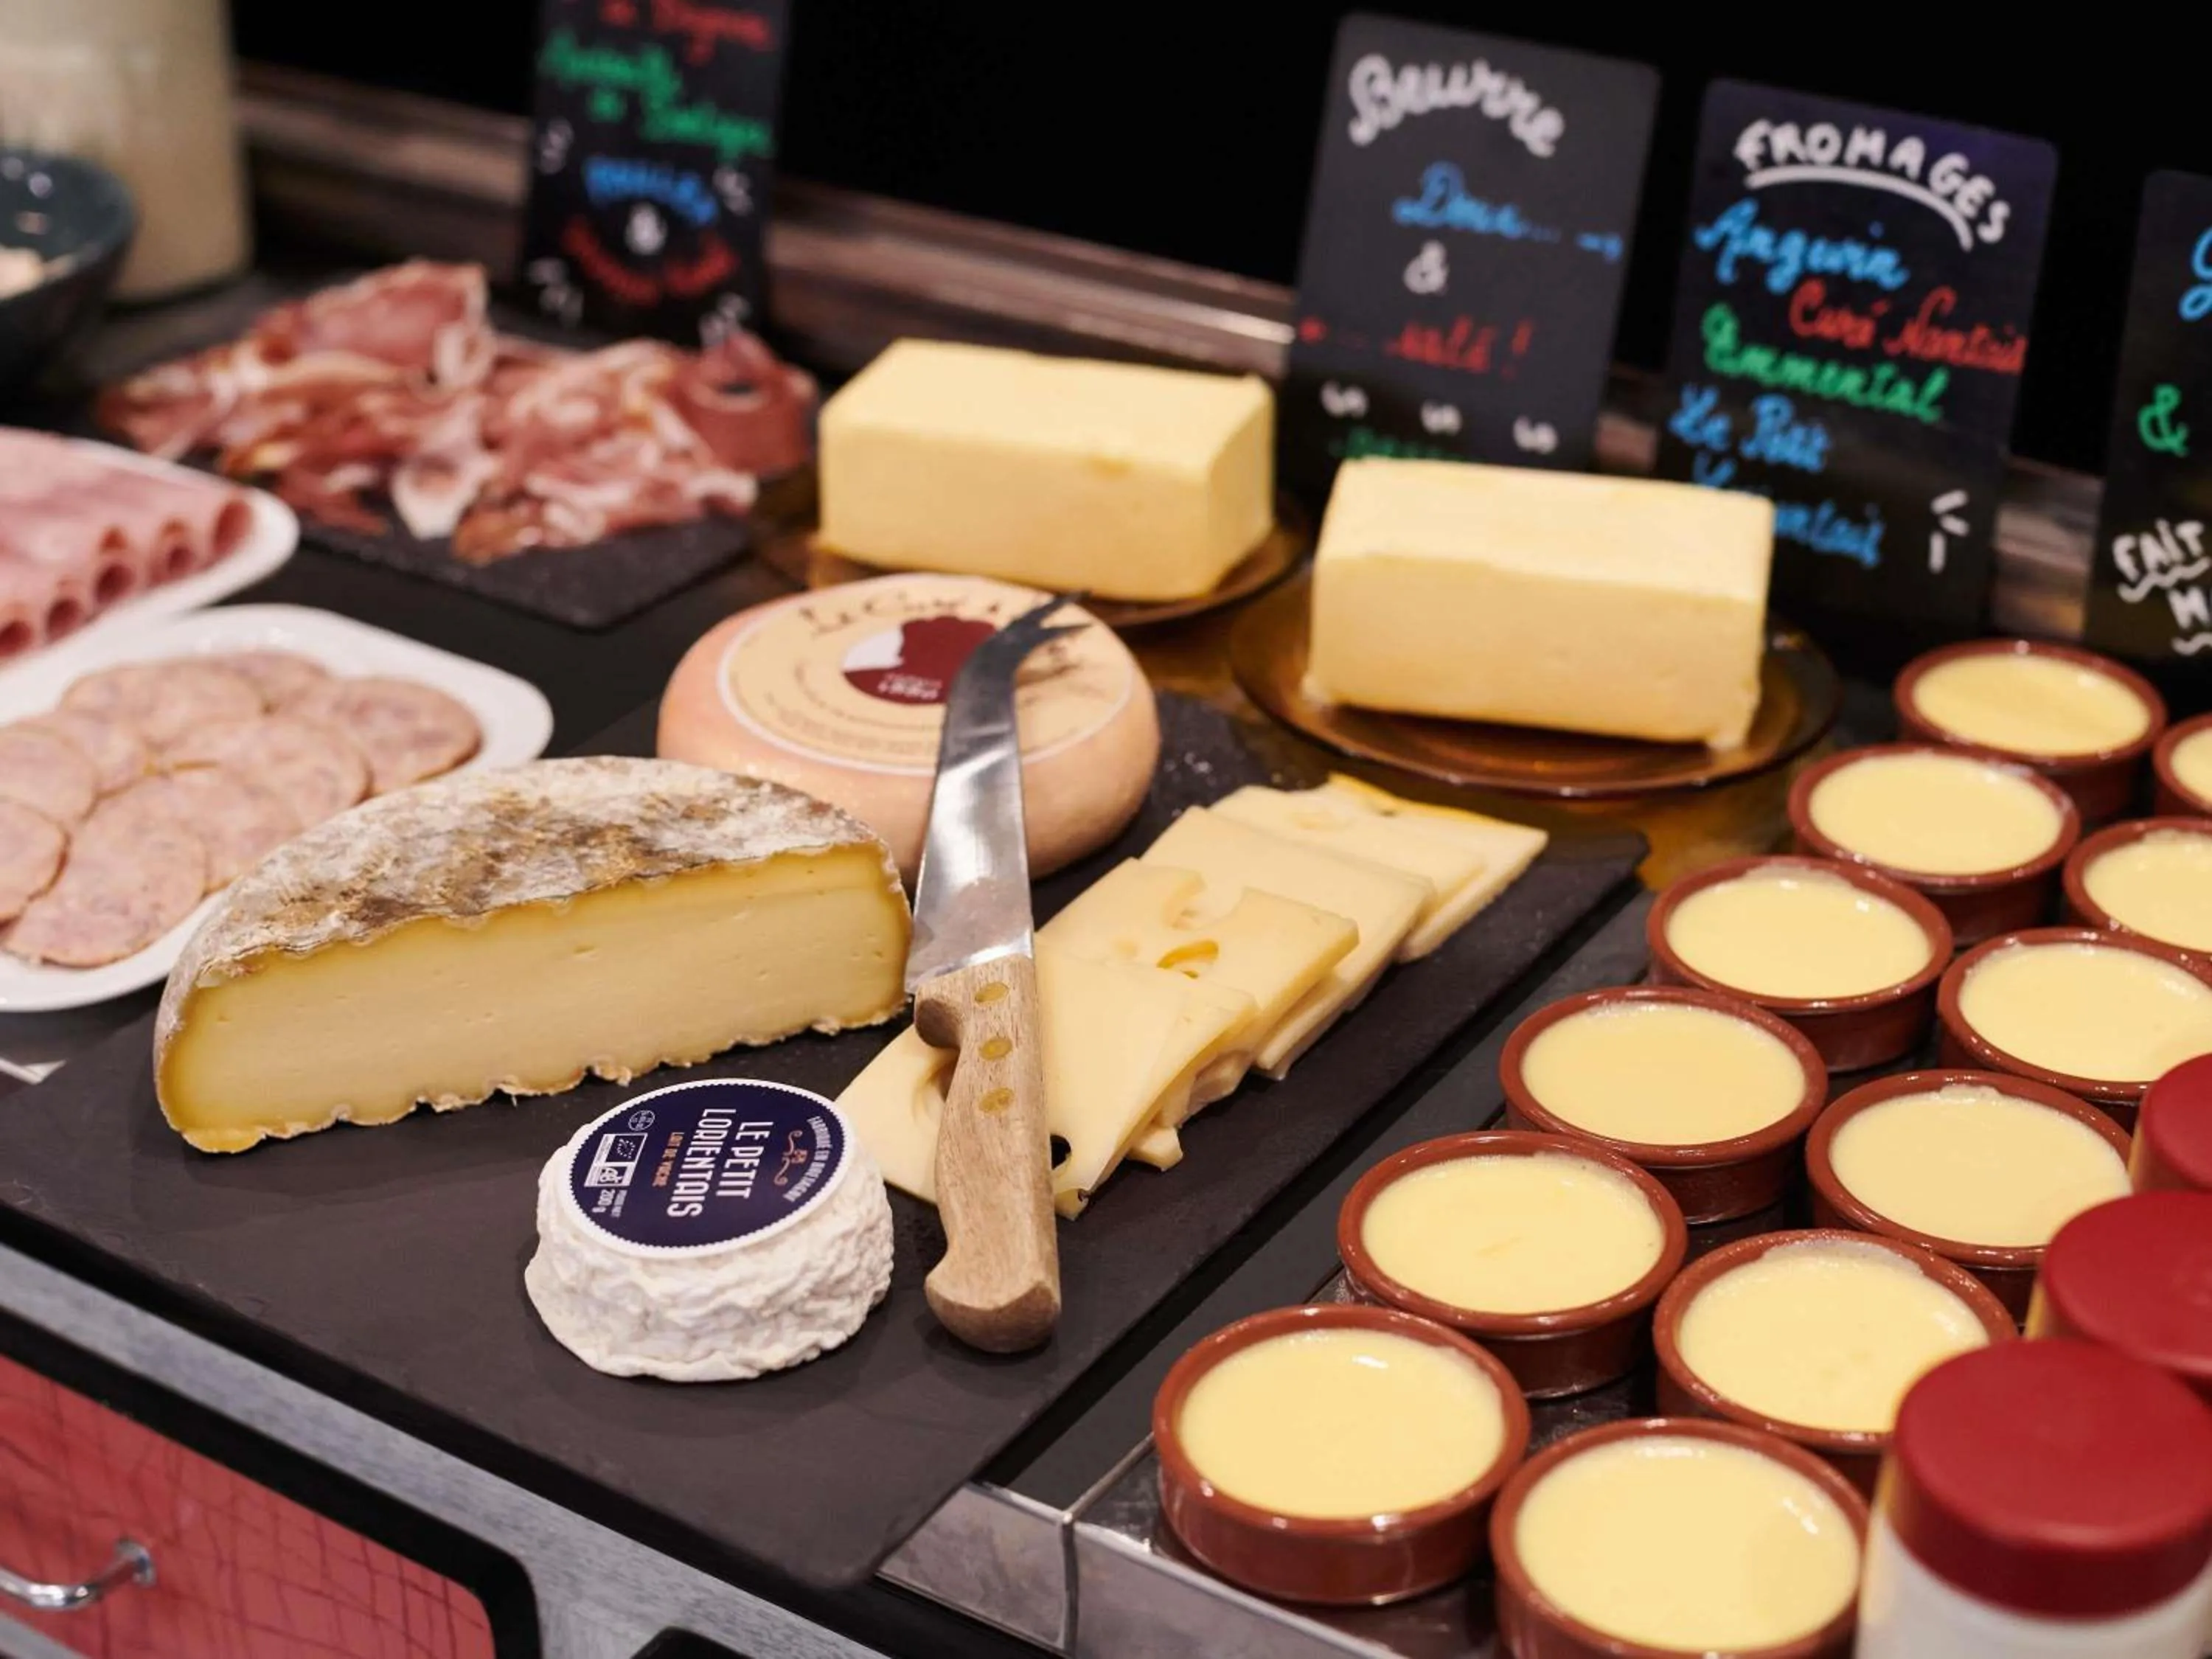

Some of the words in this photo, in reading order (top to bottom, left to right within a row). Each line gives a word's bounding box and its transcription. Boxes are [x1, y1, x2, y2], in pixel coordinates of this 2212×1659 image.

[1733, 119, 2011, 243] FROMAGES
[1702, 302, 1950, 424] Emmental
[2137, 383, 2189, 458] &
[2112, 518, 2205, 582] FAIT
[667, 1107, 737, 1217] LORIENTAIS
[735, 1121, 774, 1140] LE
[597, 1189, 616, 1206] 200
[716, 1145, 764, 1199] PETIT
